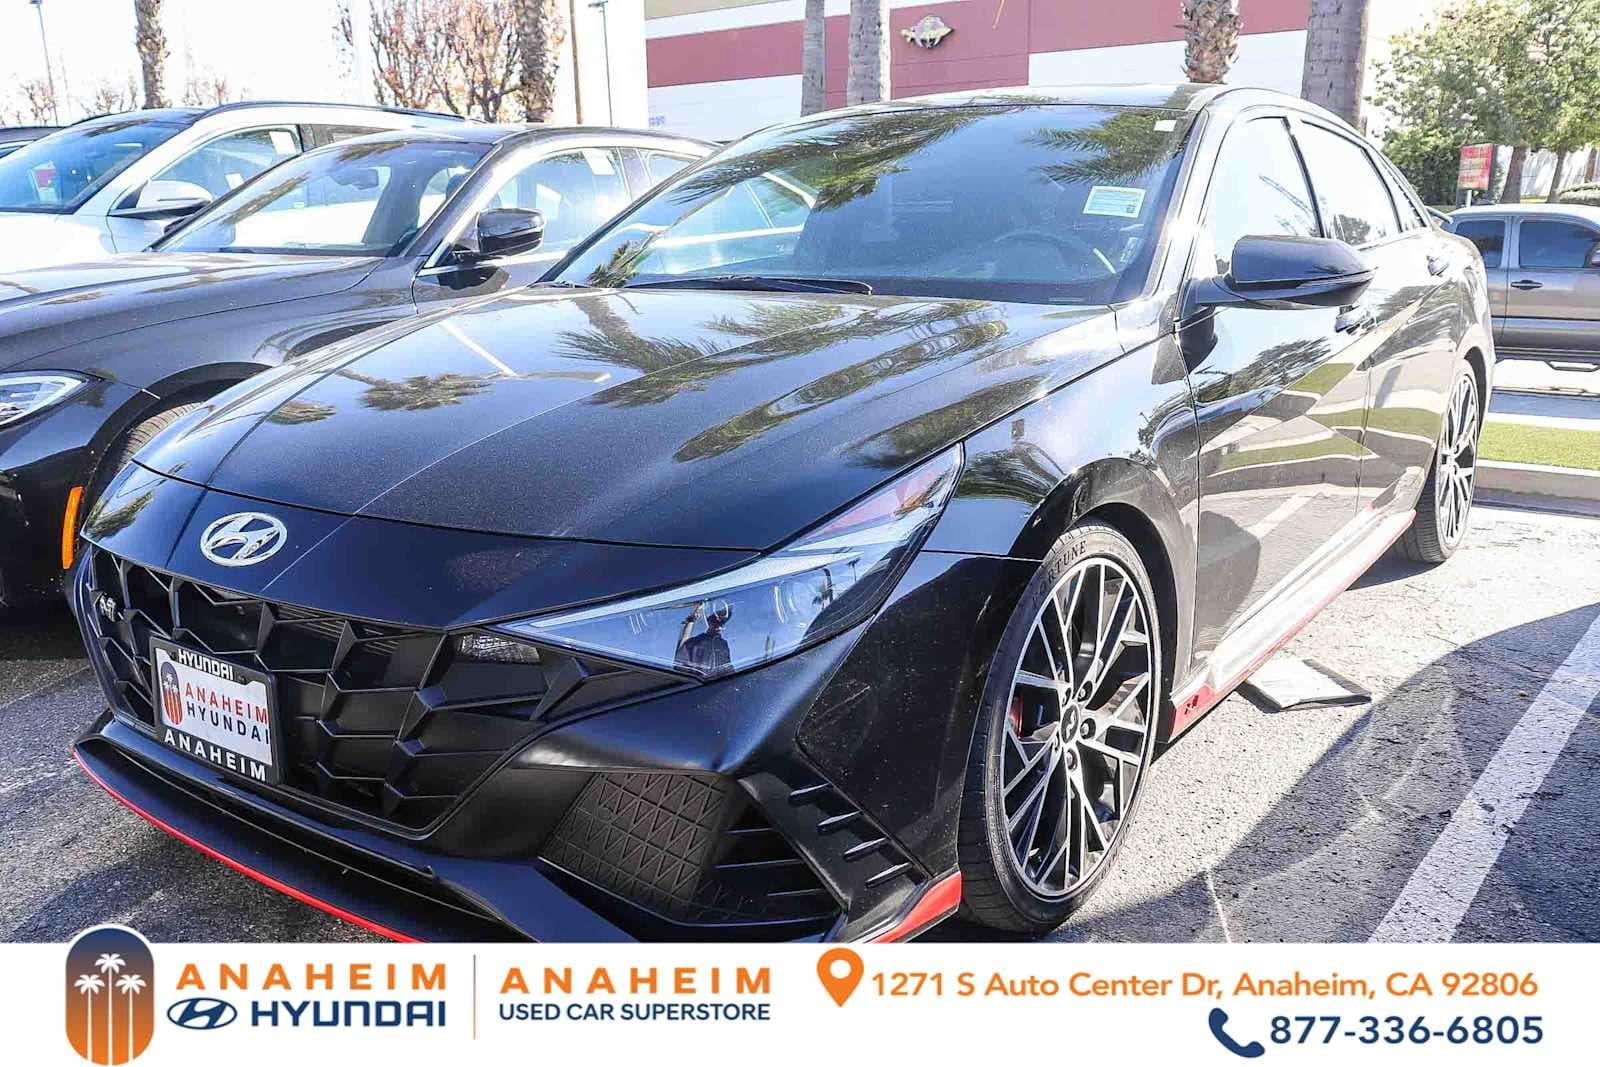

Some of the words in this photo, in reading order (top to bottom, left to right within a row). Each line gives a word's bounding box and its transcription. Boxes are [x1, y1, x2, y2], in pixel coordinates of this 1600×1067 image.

[178, 648, 234, 681] HYUNDAI
[185, 682, 268, 725] ANAHEIM
[186, 701, 270, 745] HYUNDAI
[164, 729, 266, 782] ANAHEIM
